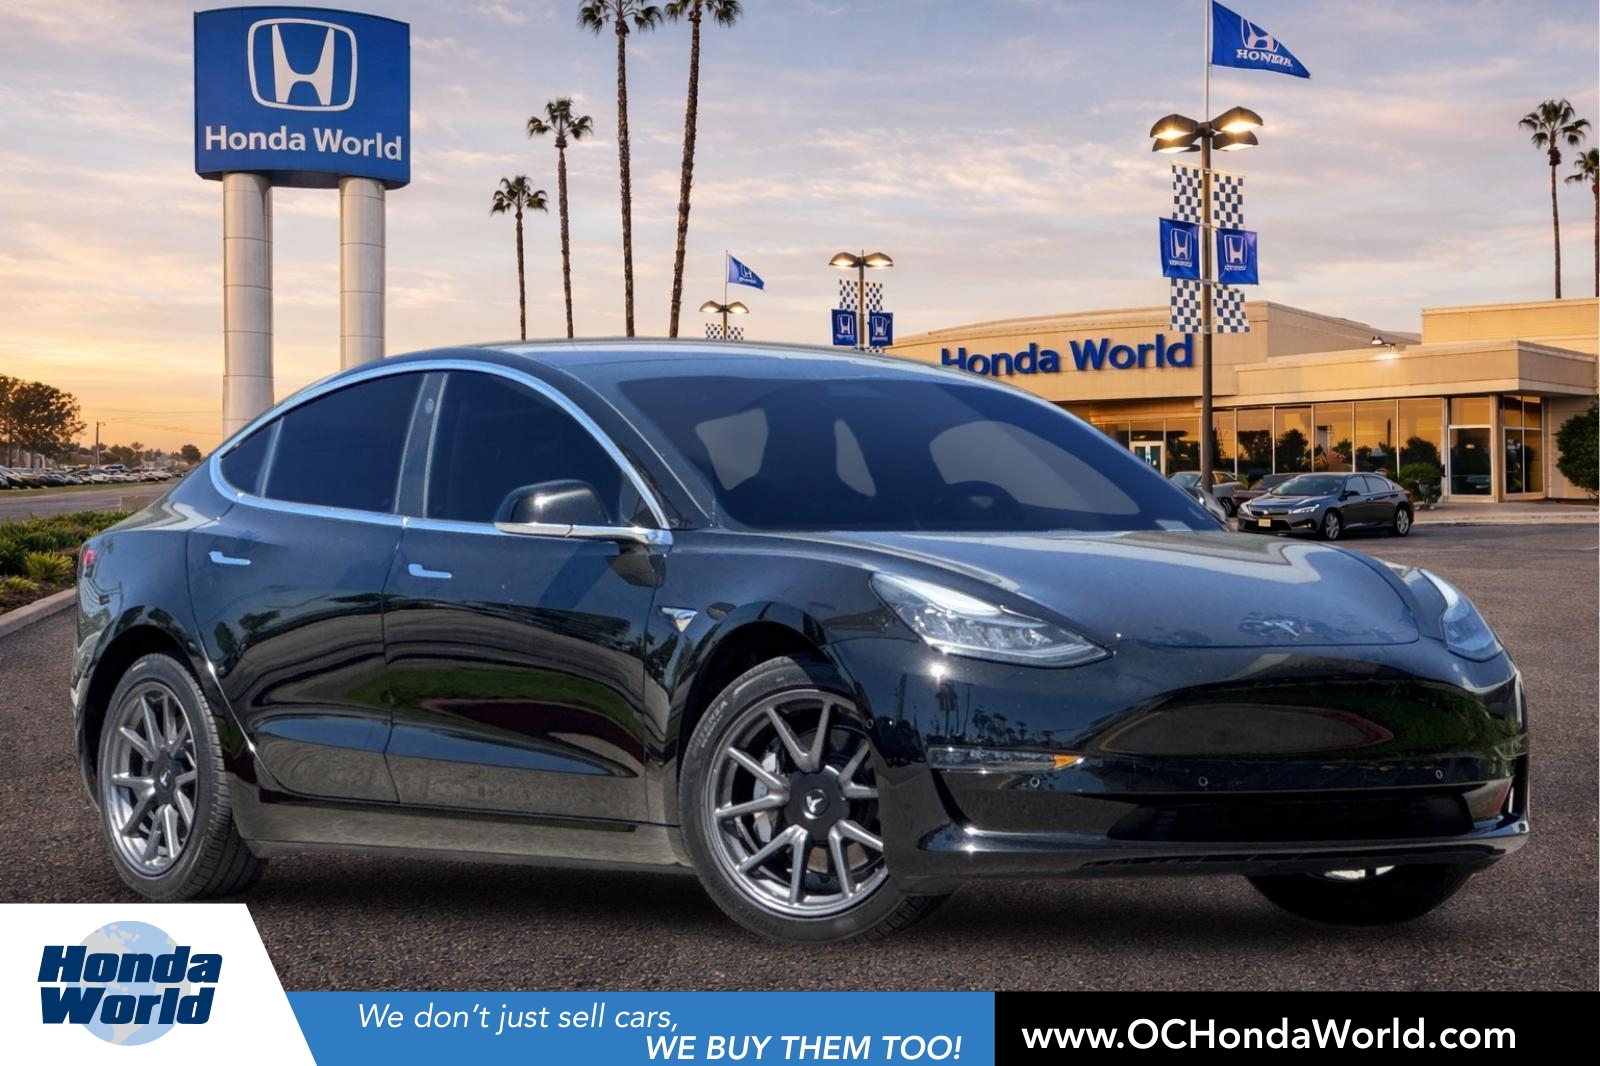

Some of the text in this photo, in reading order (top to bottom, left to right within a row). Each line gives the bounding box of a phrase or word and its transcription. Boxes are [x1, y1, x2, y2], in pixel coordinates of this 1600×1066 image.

[205, 125, 402, 161] Honda World
[941, 333, 1194, 377] Honda World
